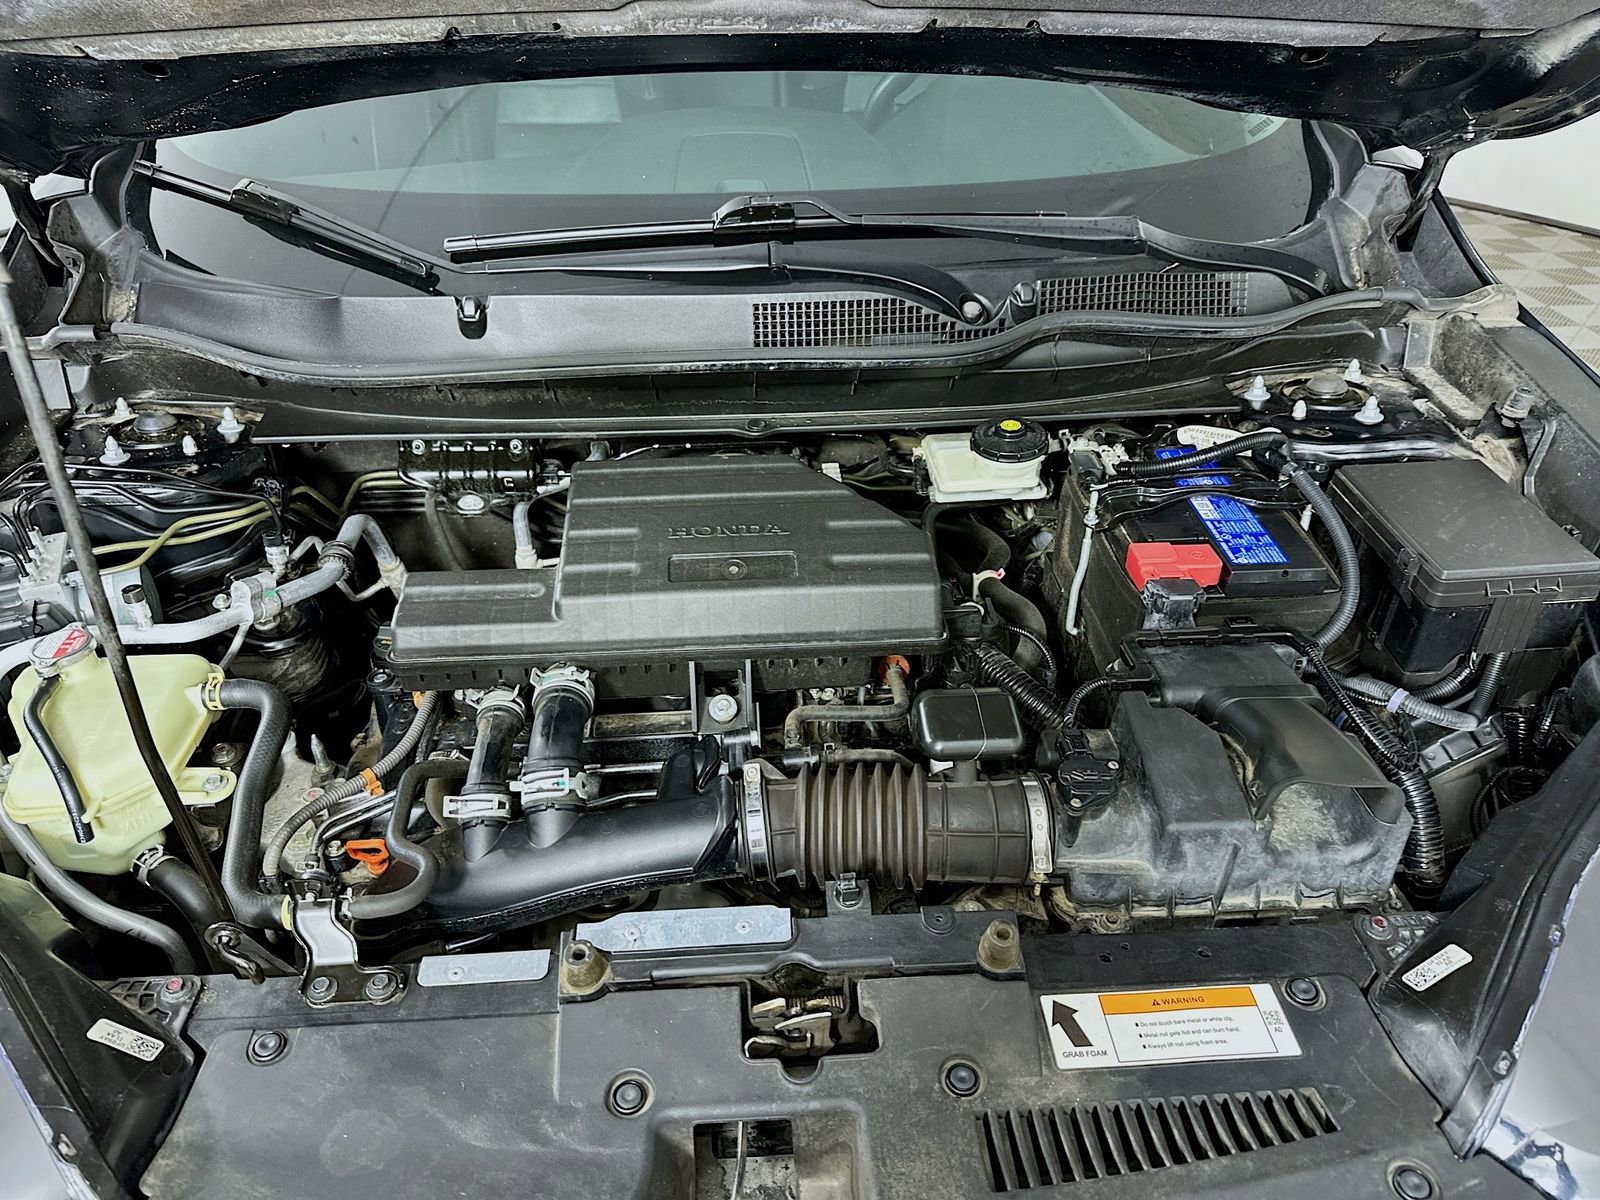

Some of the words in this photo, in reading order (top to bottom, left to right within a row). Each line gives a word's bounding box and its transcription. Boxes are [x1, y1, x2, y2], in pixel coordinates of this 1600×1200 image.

[667, 524, 791, 539] HONDA
[1161, 996, 1205, 1006] WARNING
[1086, 1050, 1109, 1058] FOAM
